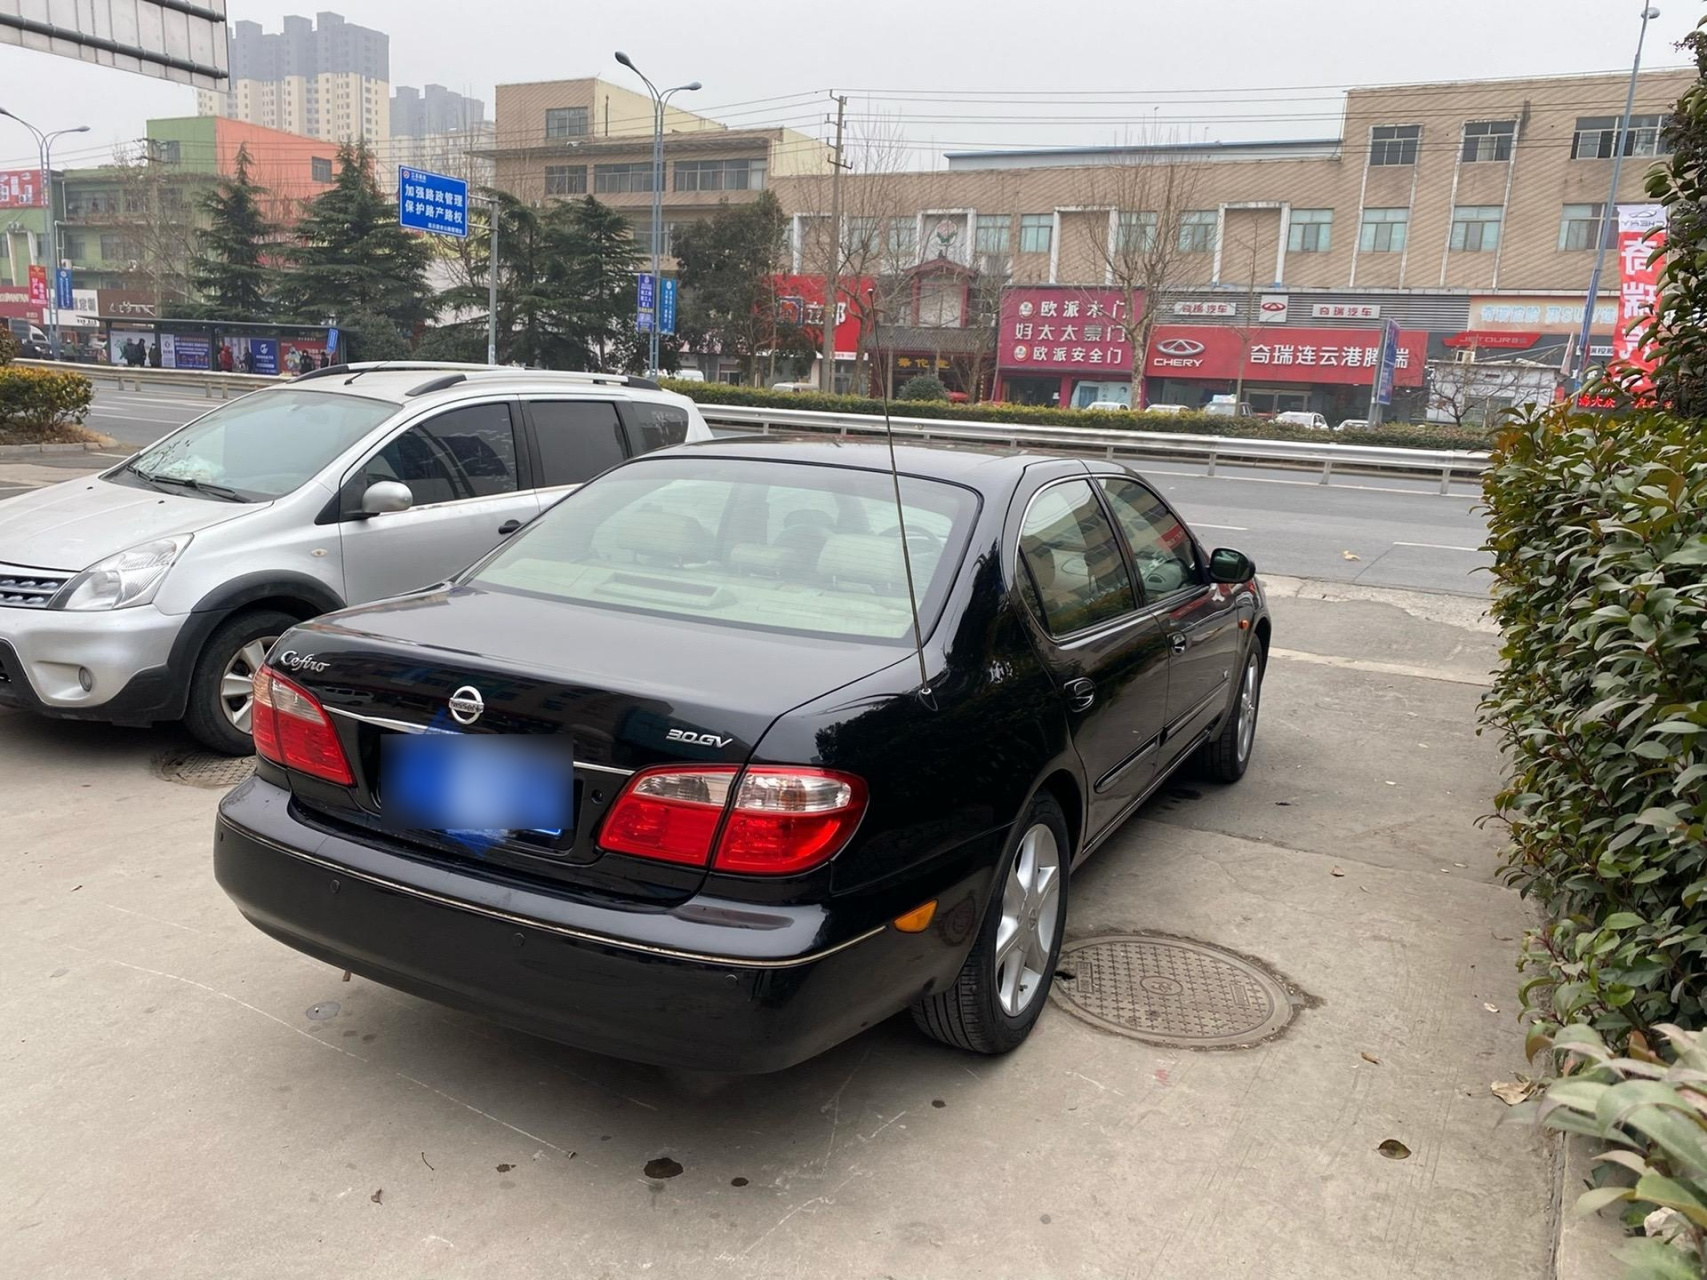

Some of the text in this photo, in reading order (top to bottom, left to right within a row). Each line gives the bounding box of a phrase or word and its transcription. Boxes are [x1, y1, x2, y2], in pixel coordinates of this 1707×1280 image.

[404, 184, 463, 207] 加强路政管理
[404, 200, 463, 224] 保护路产路权
[1040, 300, 1126, 319] 欧派木门
[1319, 306, 1372, 317] 奇瑞汽车
[1015, 323, 1126, 342] 好太太豪门
[1033, 346, 1122, 364] 欧派安全门
[1154, 357, 1204, 368] CHERY
[281, 650, 331, 673] Cefiro
